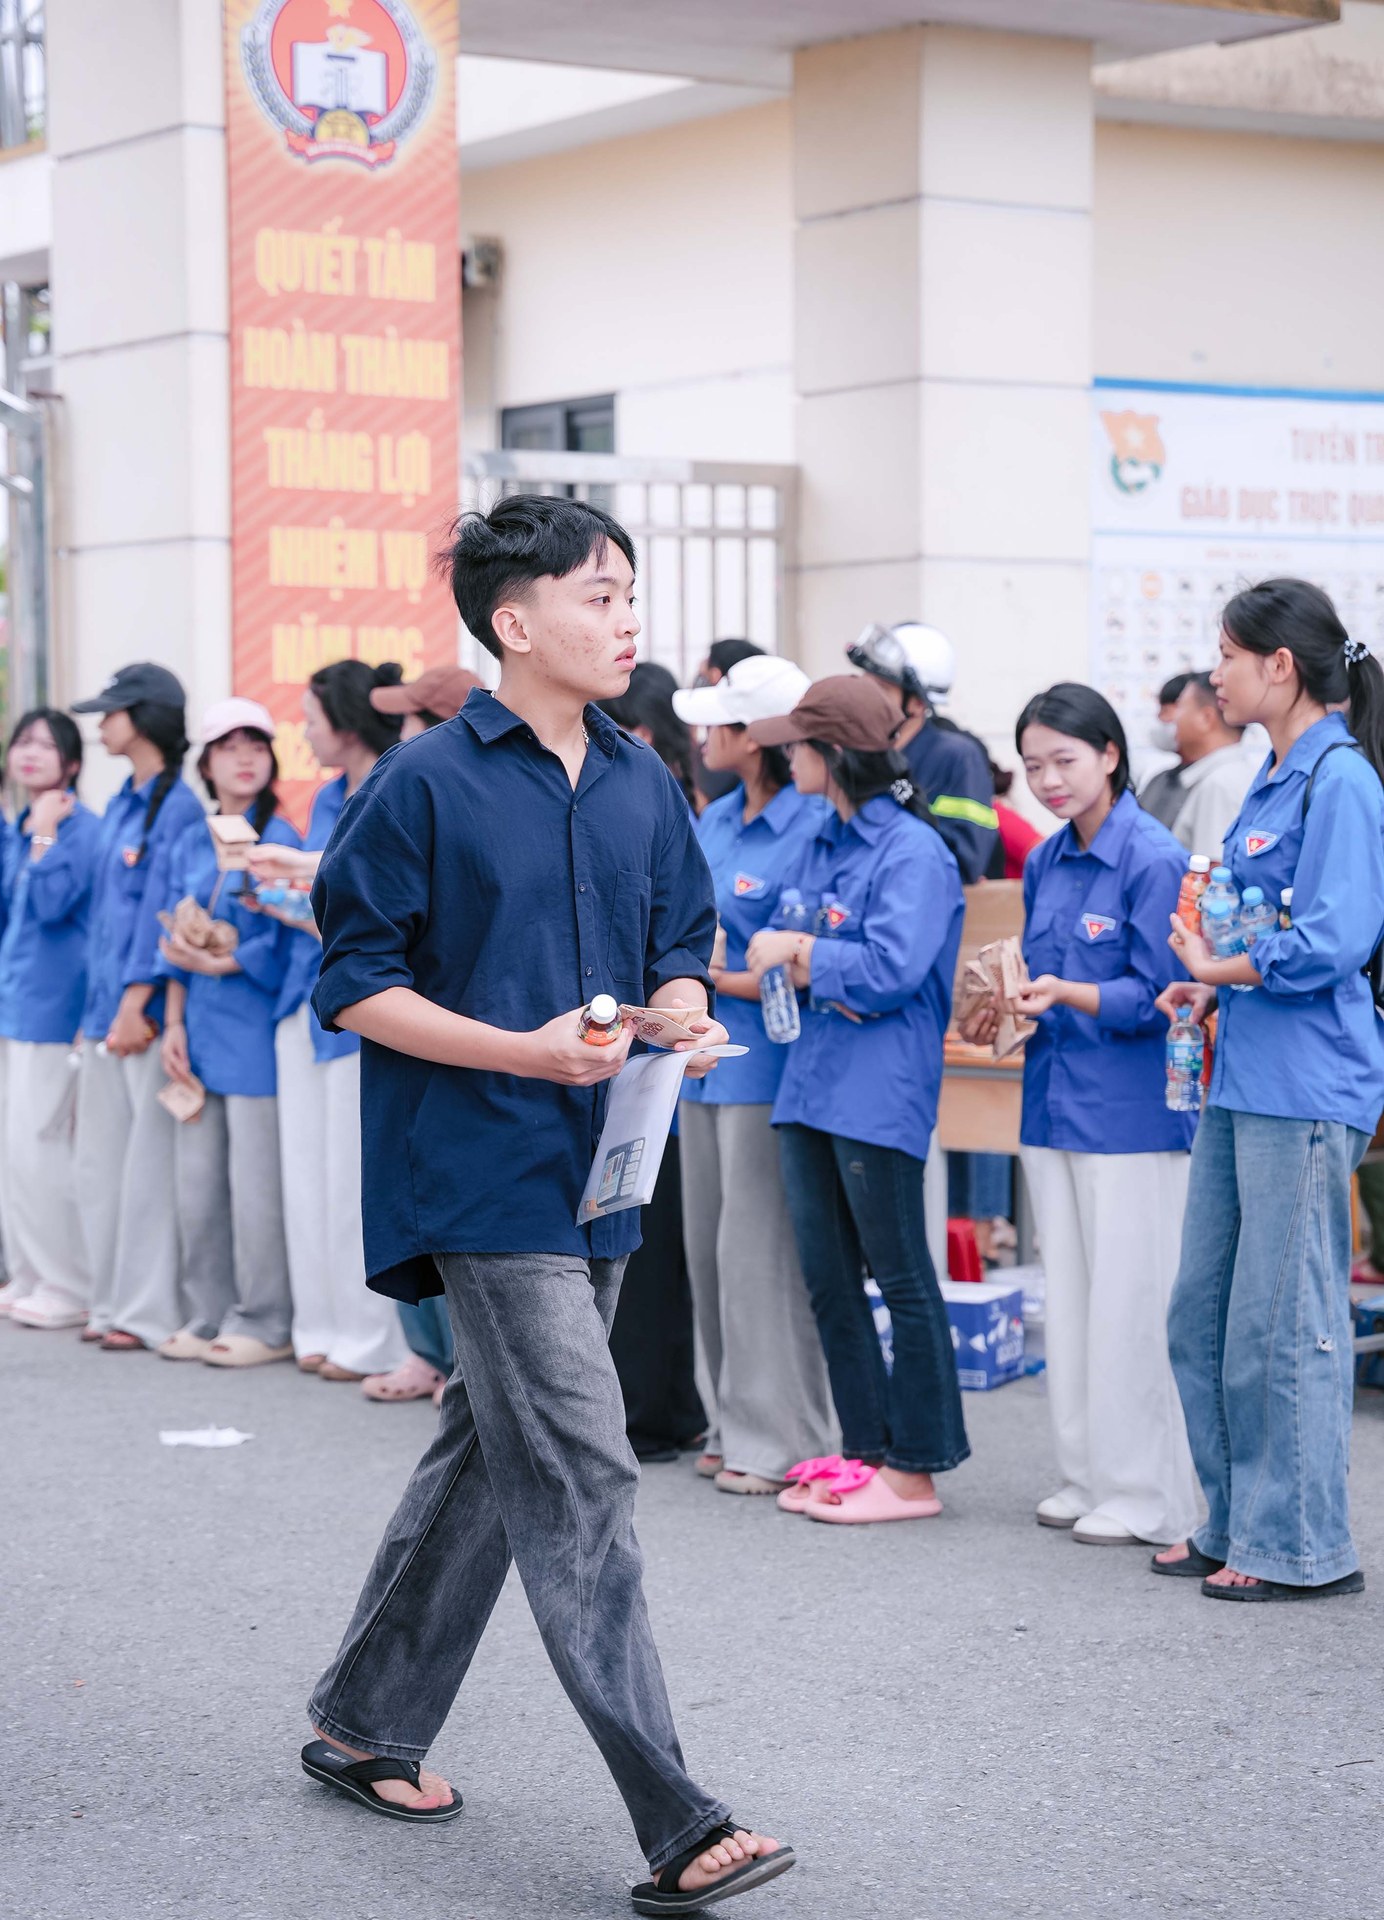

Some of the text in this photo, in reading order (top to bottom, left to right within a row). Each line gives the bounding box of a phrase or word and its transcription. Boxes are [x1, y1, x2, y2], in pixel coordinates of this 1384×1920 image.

[256, 215, 436, 302] QUYẾT TÂM
[243, 317, 449, 400] HOÀN THÀNH
[263, 408, 373, 493] THẮNG
[382, 530, 428, 604] VỤ
